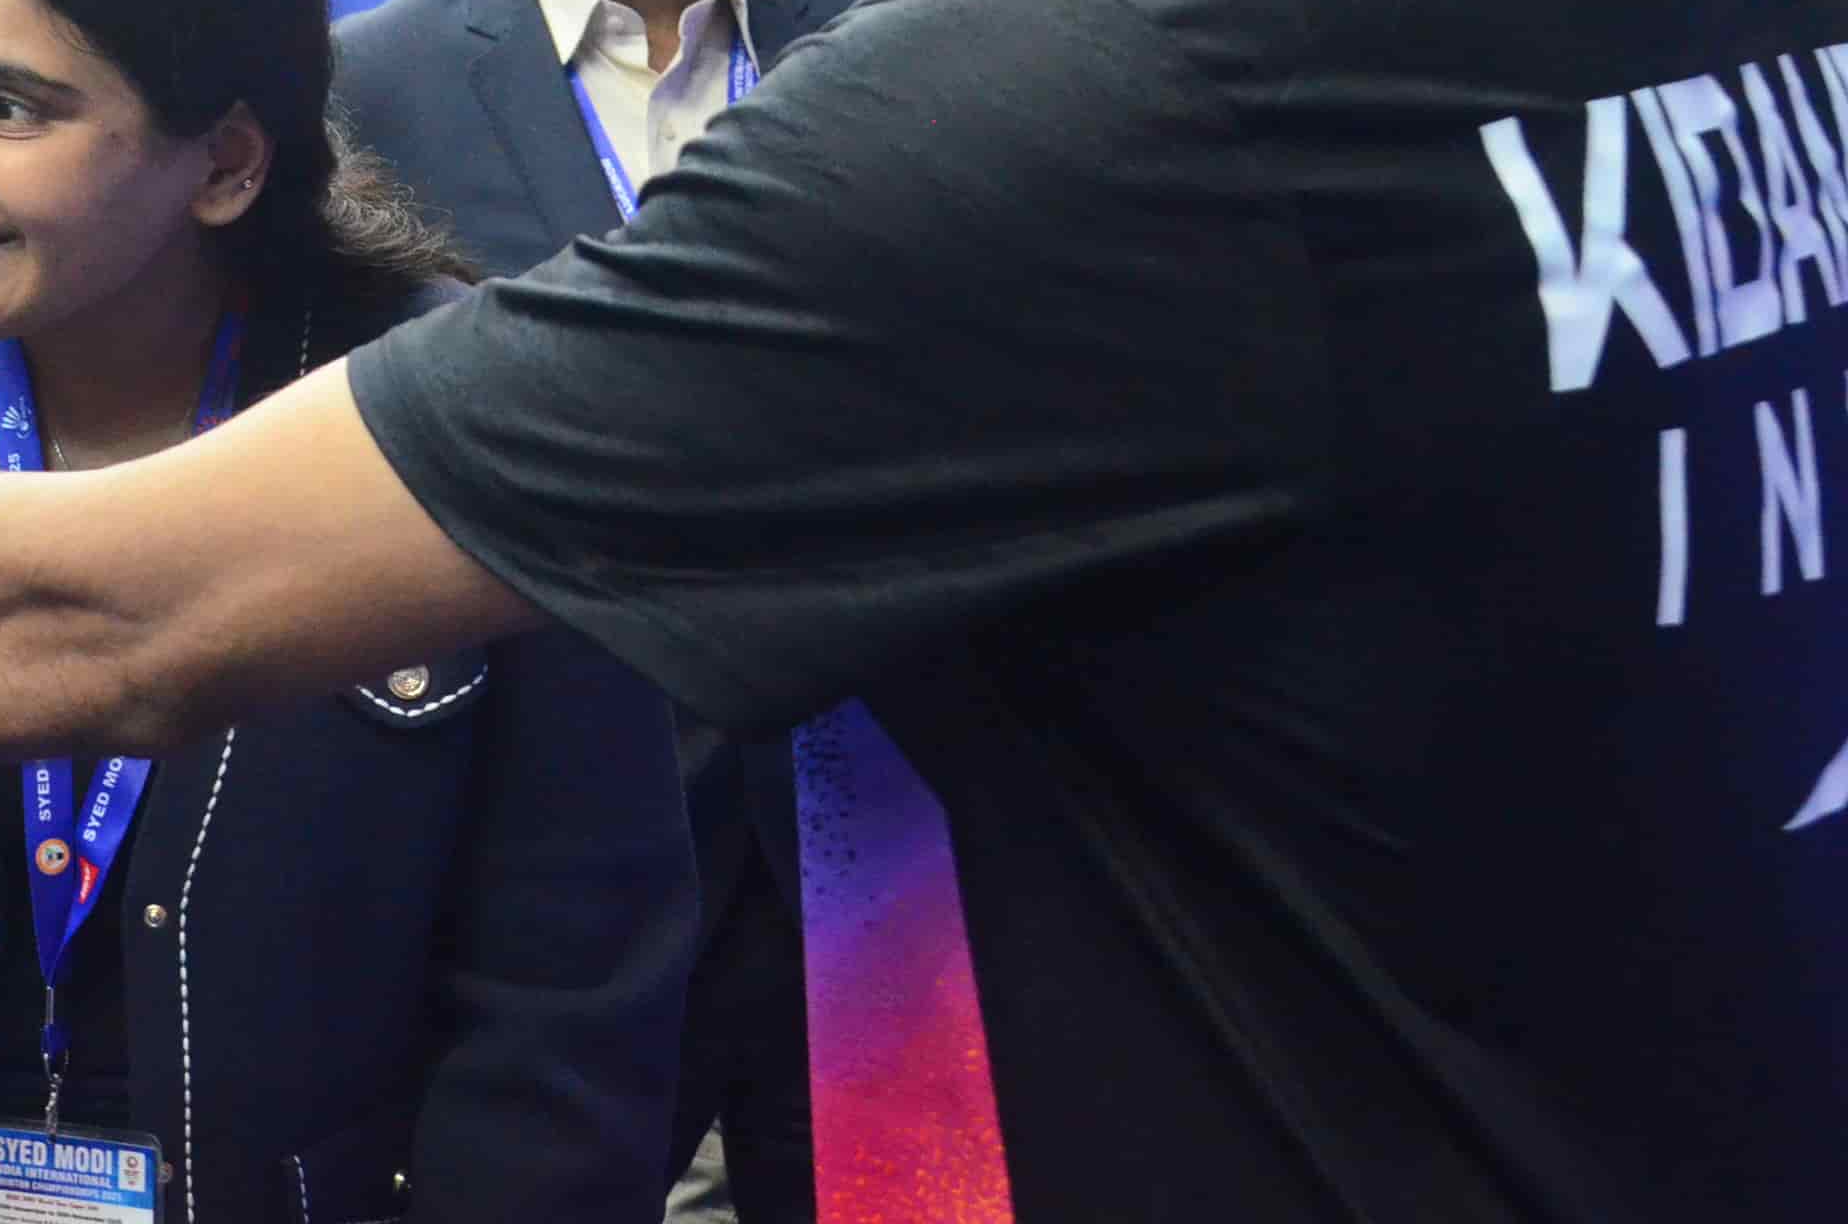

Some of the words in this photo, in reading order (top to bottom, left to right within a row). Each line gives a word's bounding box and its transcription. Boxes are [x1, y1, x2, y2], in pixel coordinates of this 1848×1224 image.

[36, 769, 52, 822] SYED
[82, 791, 111, 843] SYED
[102, 755, 124, 789] MO
[54, 1143, 113, 1175] MODI
